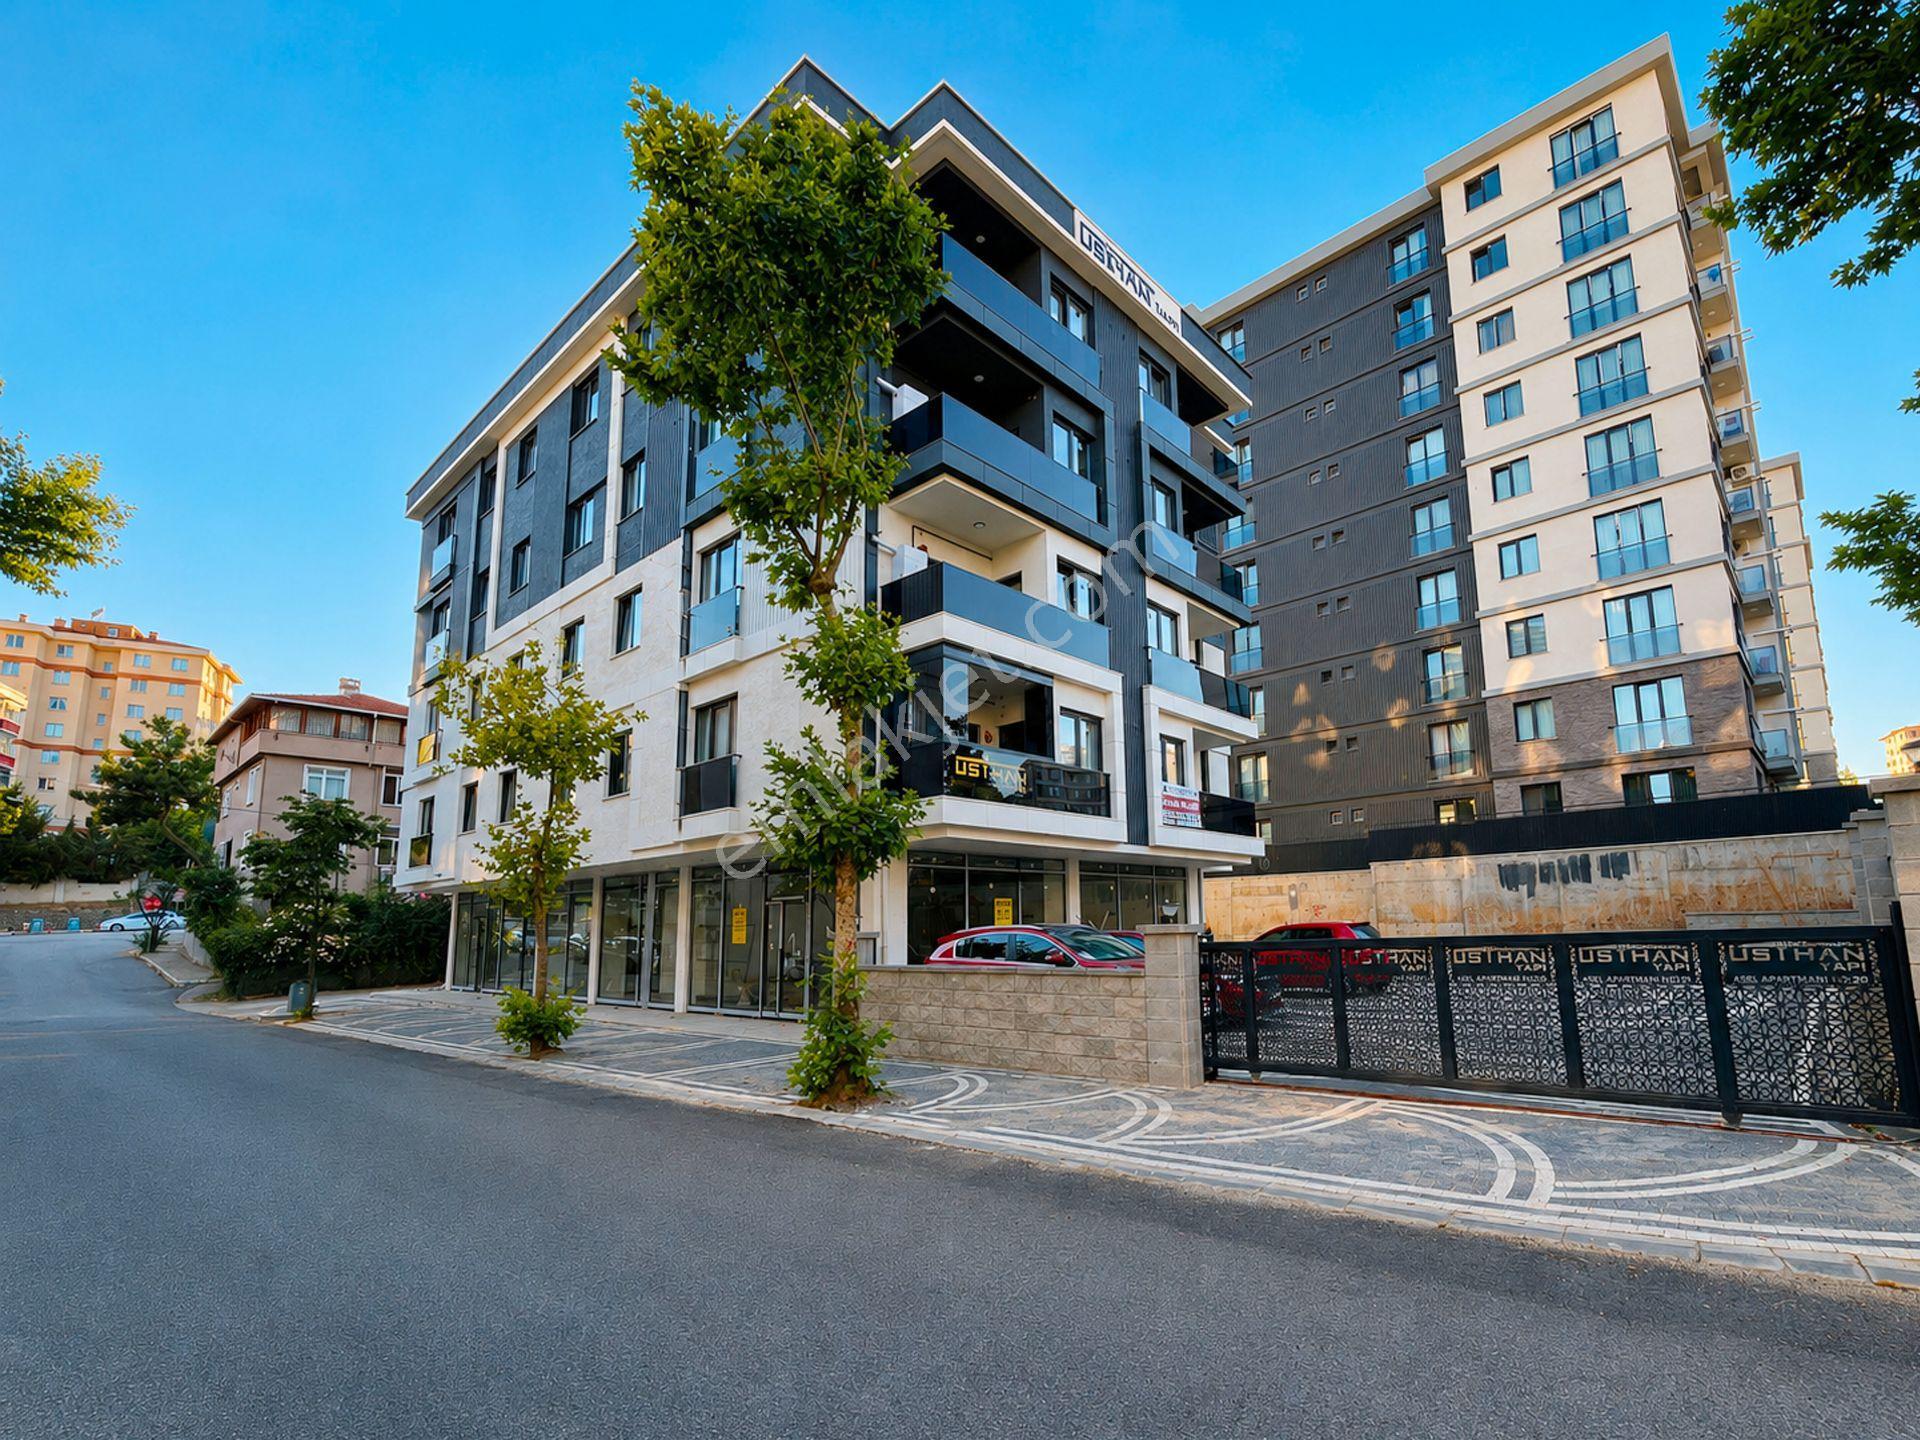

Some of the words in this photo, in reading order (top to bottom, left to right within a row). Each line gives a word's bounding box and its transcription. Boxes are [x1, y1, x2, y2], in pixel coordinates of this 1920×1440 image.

[1453, 947, 1547, 964] USTHAN
[1579, 945, 1689, 963] USTHAN
[1728, 942, 1866, 962] USTHAN
[1515, 963, 1547, 972] YAPI
[1652, 962, 1690, 972] YAPI
[1819, 961, 1867, 973] YAPI
